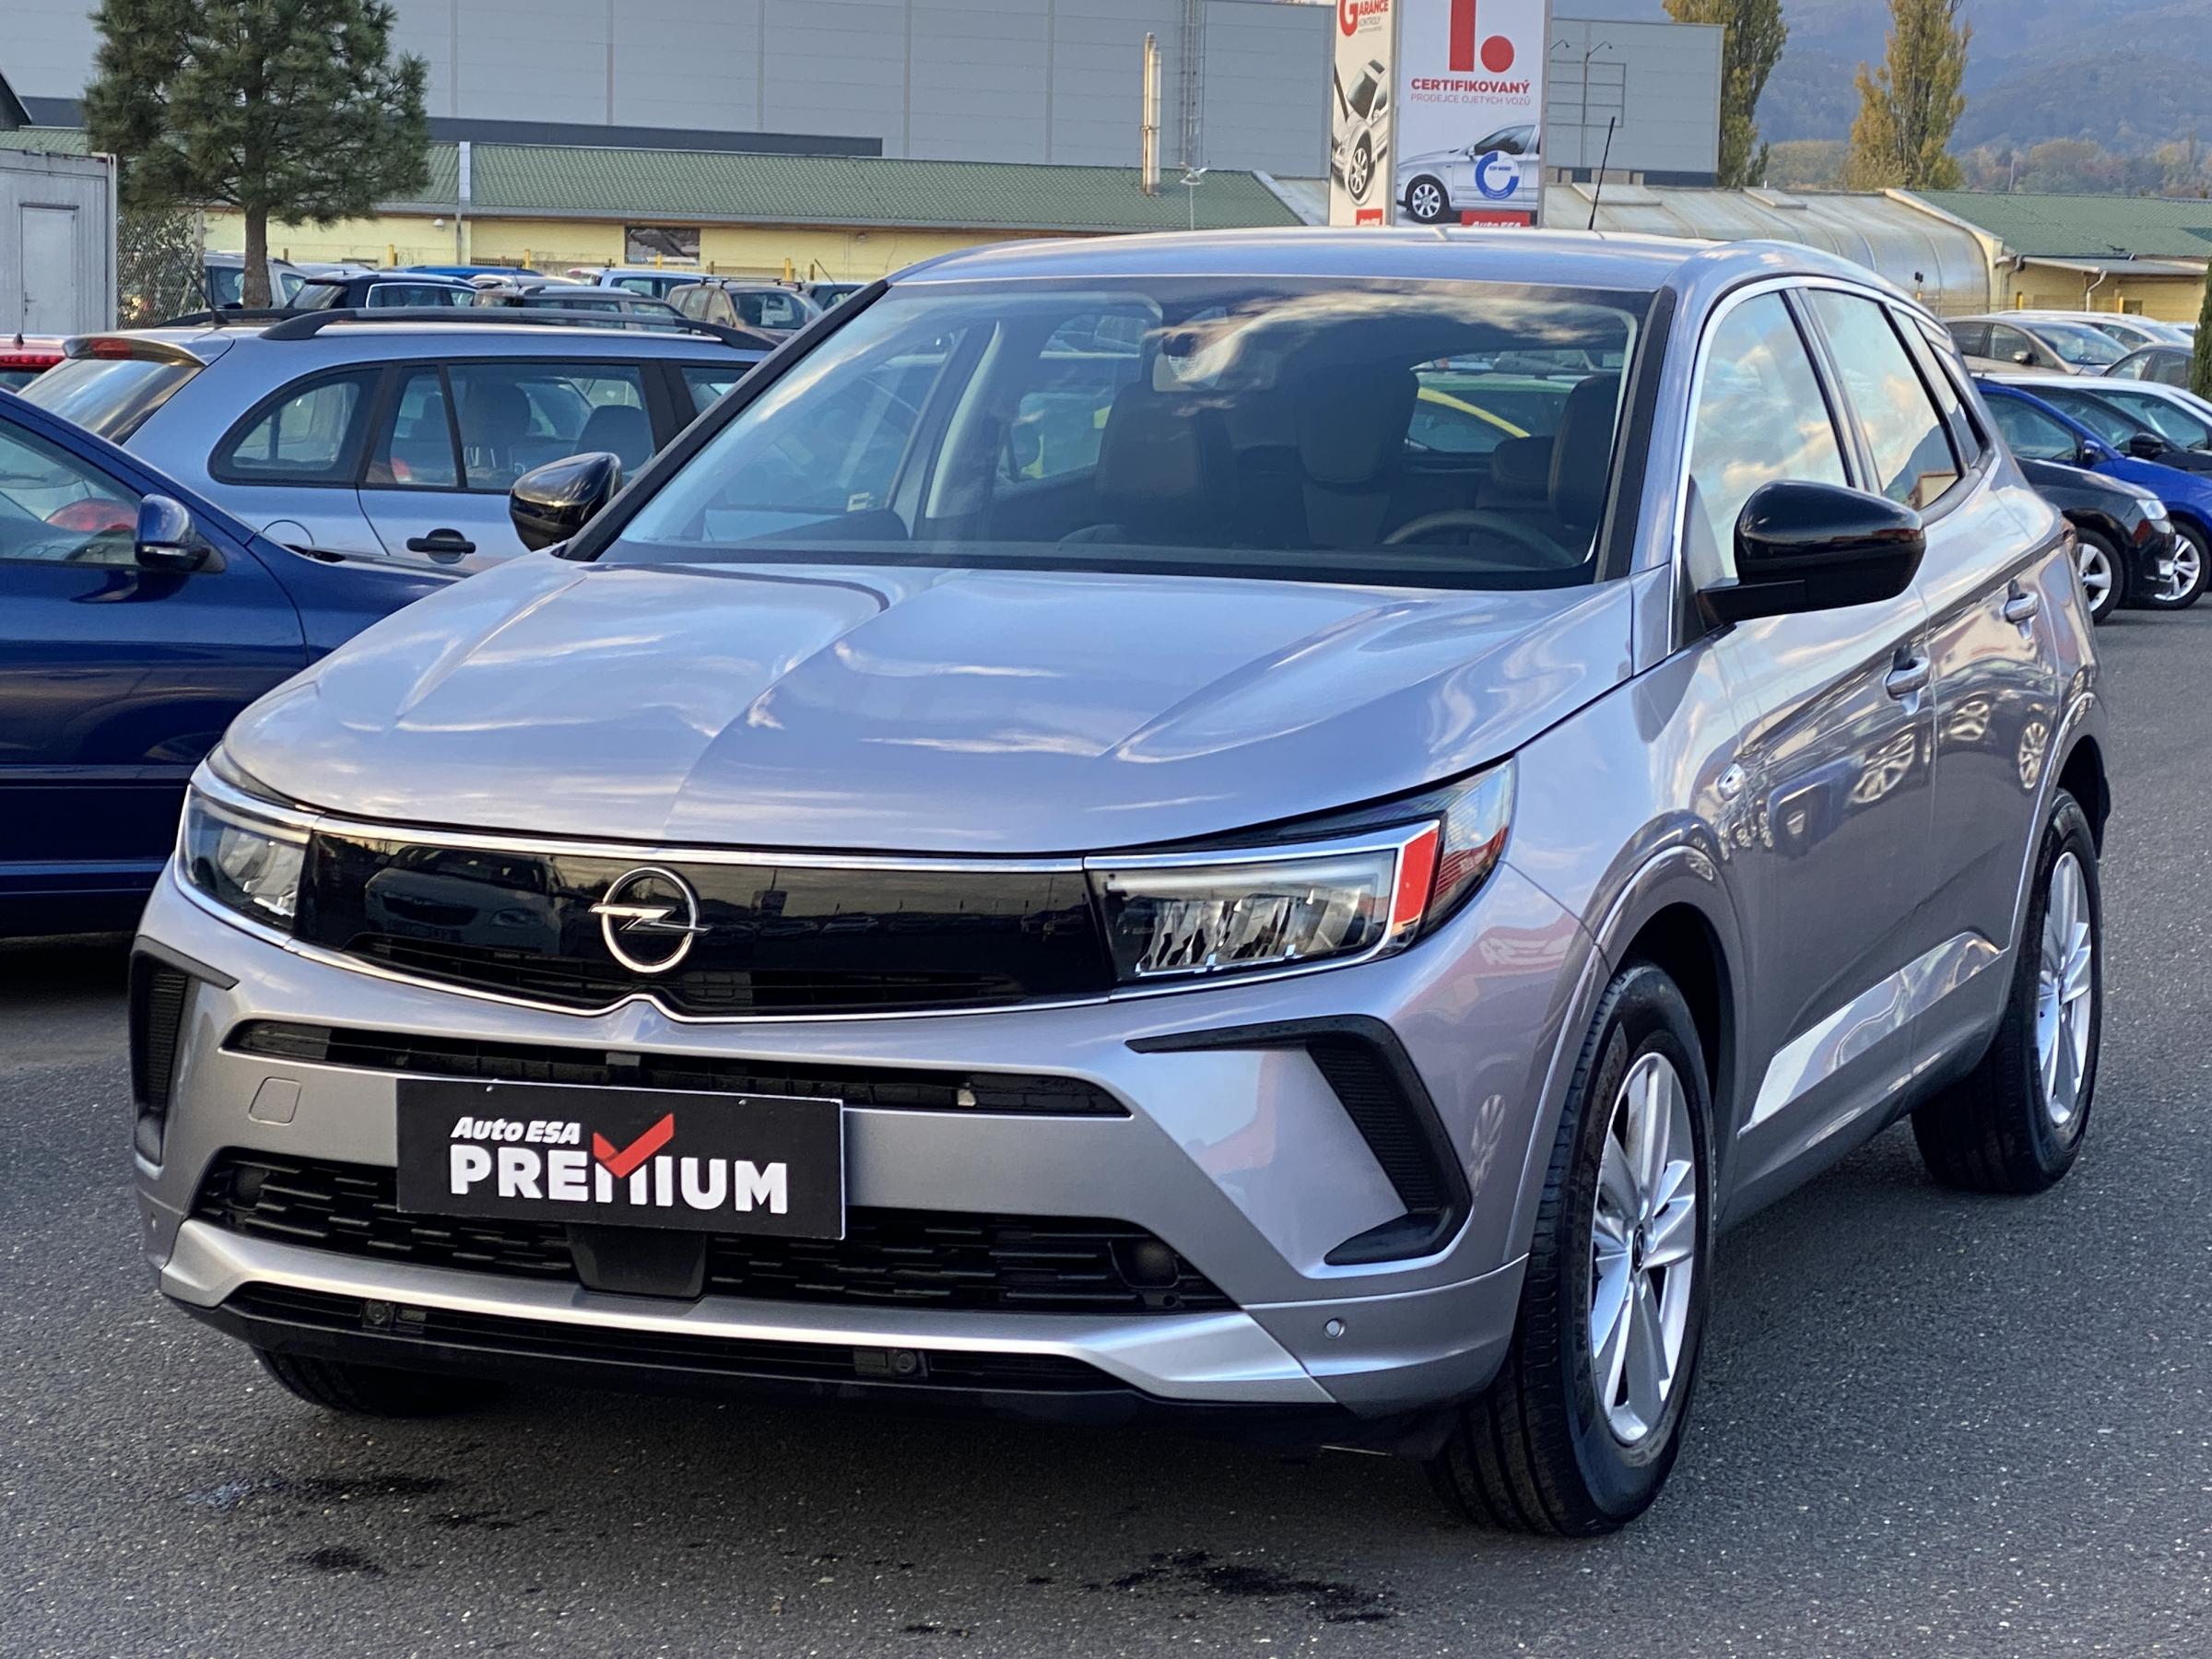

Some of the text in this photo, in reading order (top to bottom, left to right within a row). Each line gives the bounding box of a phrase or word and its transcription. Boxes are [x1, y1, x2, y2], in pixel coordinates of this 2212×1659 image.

[1411, 77, 1531, 94] CERTIFIKOVANÝ
[1410, 93, 1459, 103] PRODEJCE
[450, 1116, 581, 1145] Auto ESA
[449, 1143, 788, 1215] PREMIUM
